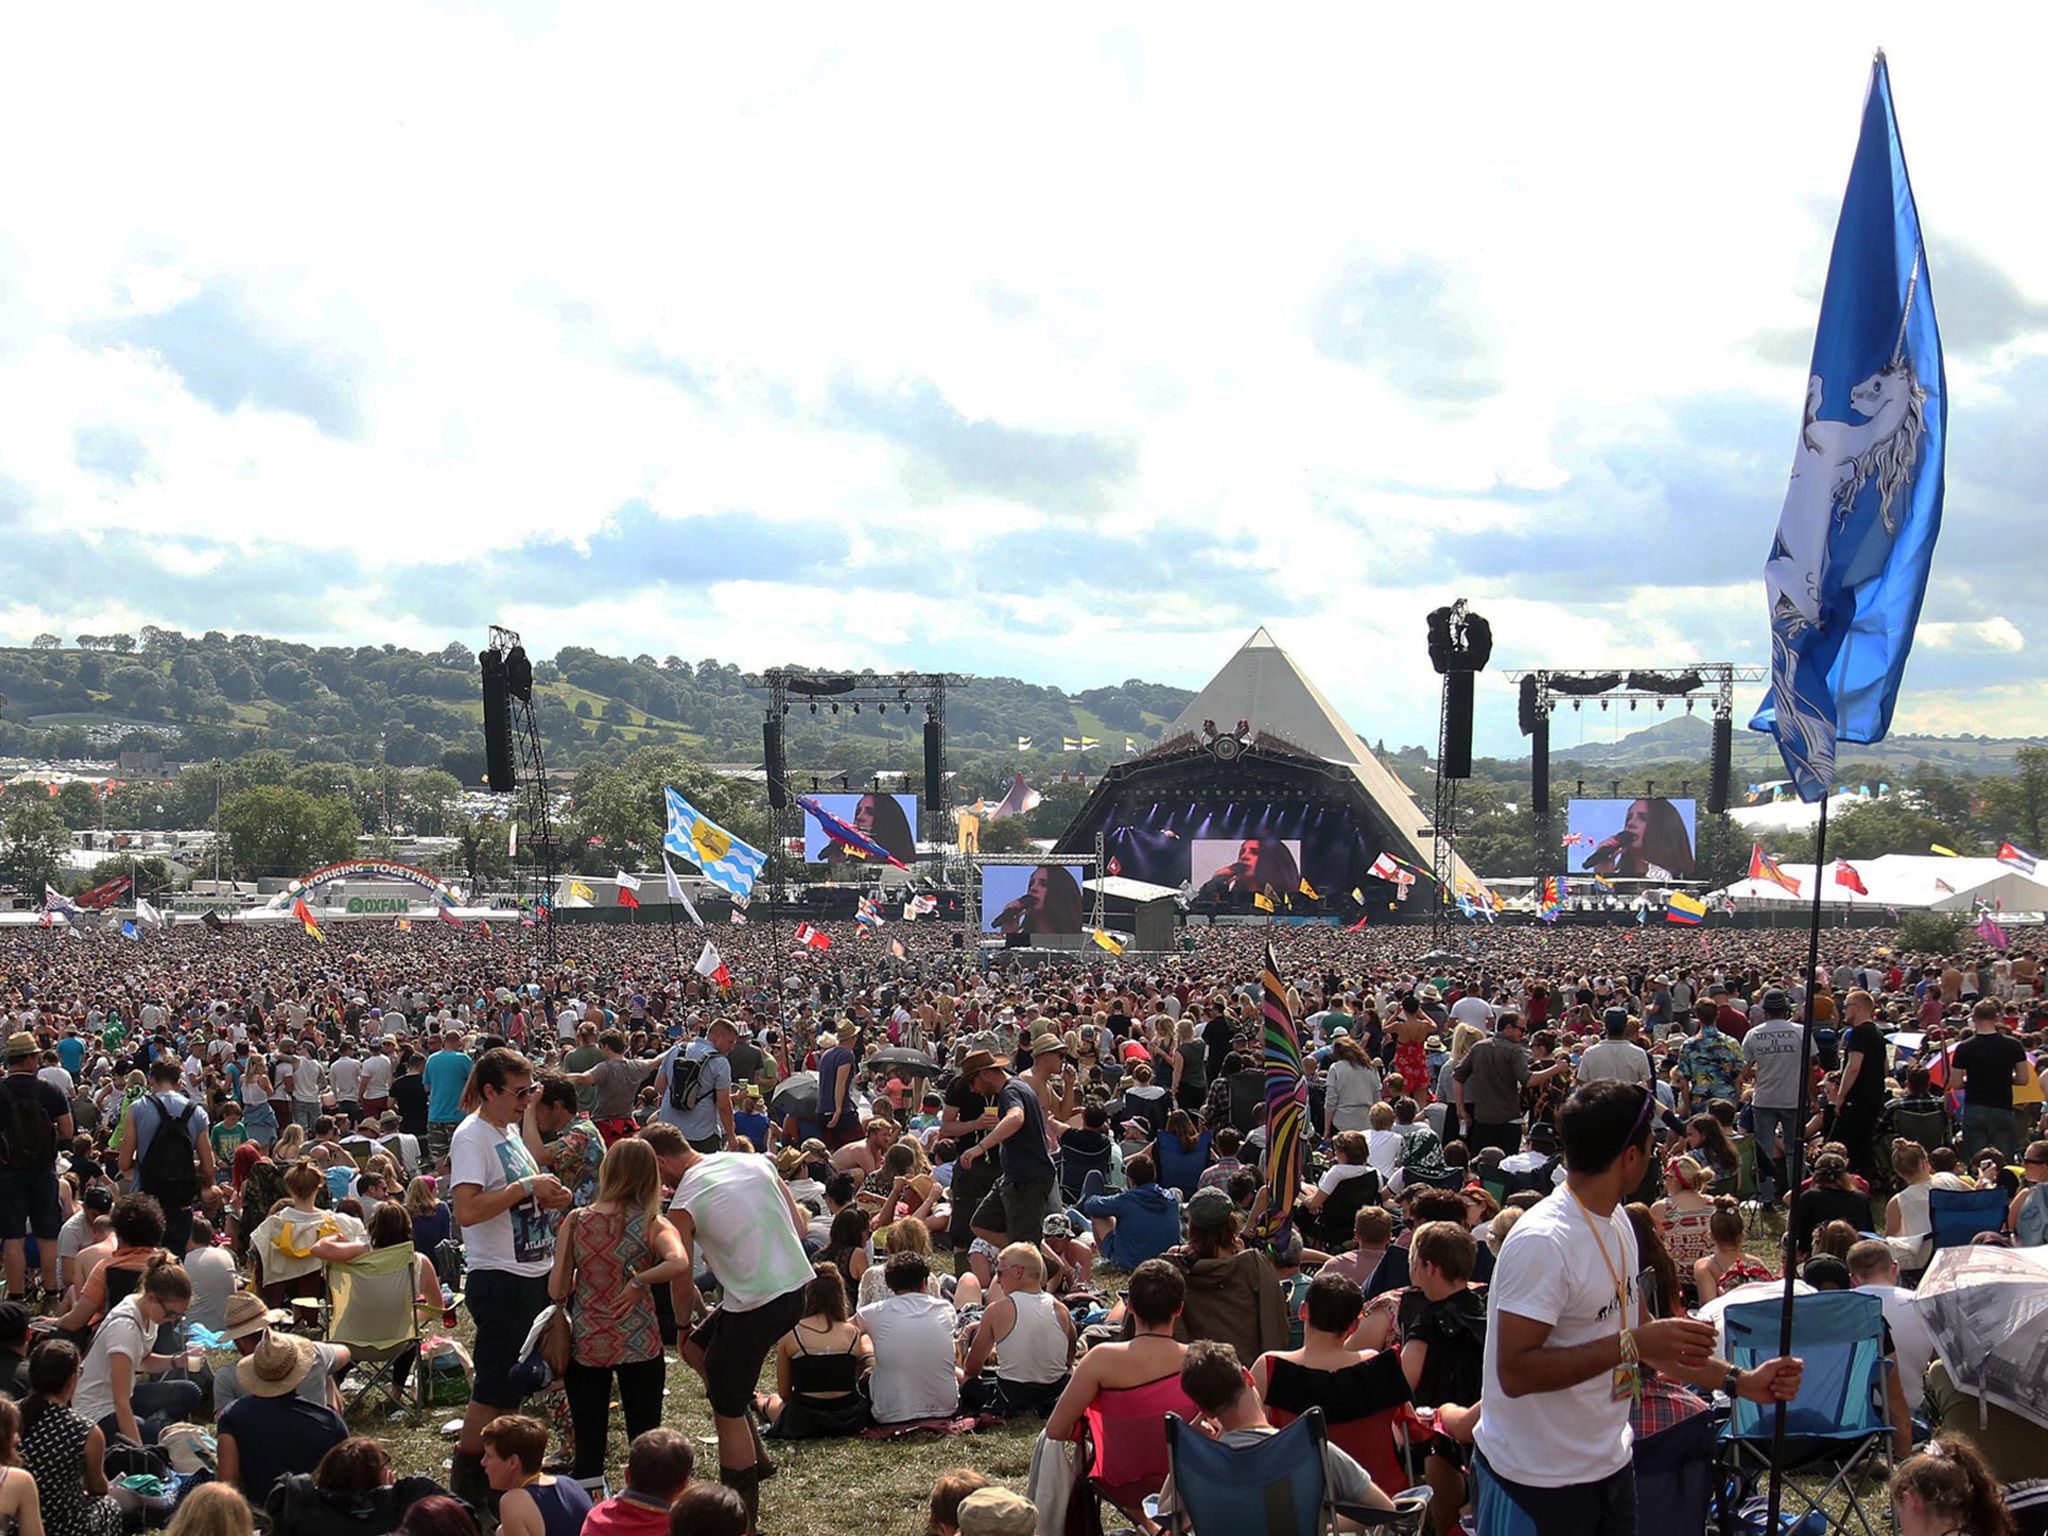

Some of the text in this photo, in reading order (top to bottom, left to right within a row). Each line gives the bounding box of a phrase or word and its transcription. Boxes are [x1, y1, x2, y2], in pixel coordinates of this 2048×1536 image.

[302, 863, 436, 890] WORKING TOGETHER
[364, 899, 408, 912] OXFAM
[1755, 1031, 1792, 1040] MENACE
[1756, 1045, 1796, 1053] SOCIETY
